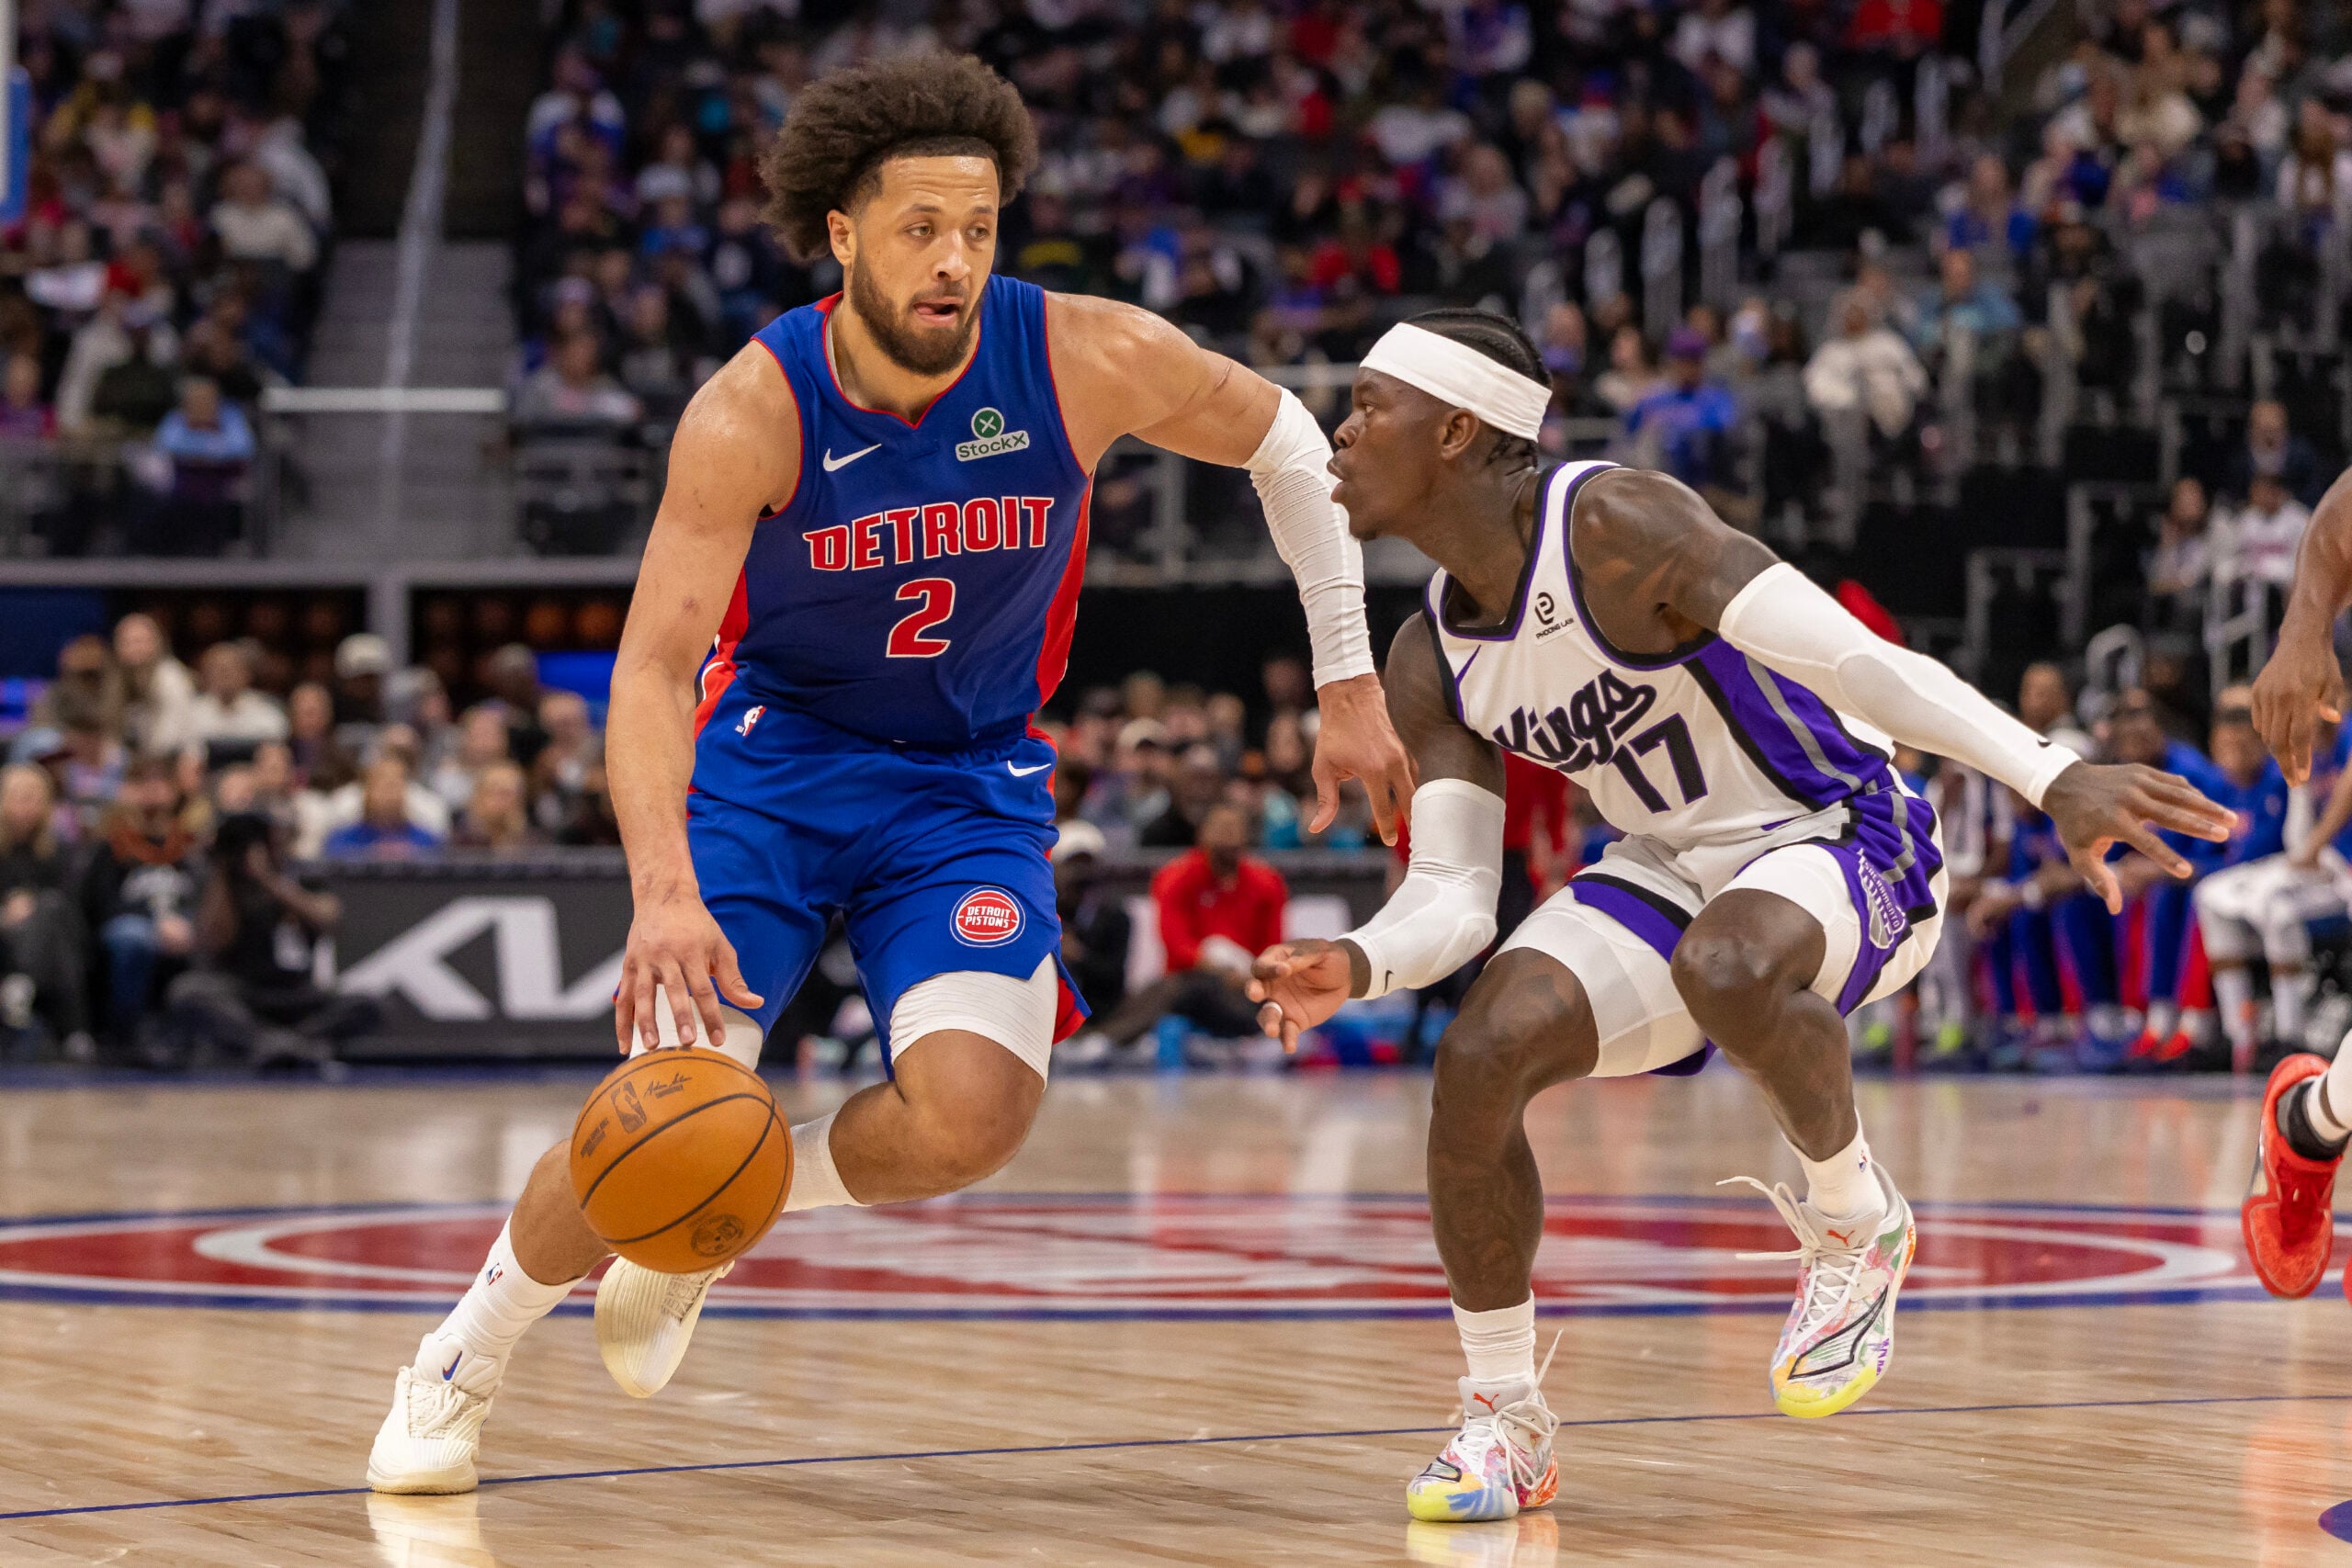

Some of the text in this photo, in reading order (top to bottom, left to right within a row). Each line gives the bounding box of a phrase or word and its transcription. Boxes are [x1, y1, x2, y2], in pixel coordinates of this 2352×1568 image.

[958, 432, 1027, 458] StockX
[802, 496, 1055, 571] DETROIT
[886, 577, 956, 658] 2
[1492, 668, 1657, 774] Kings
[1608, 712, 1709, 815] 17
[965, 916, 1011, 929] PISTONS
[967, 906, 1012, 919] DETROIT
